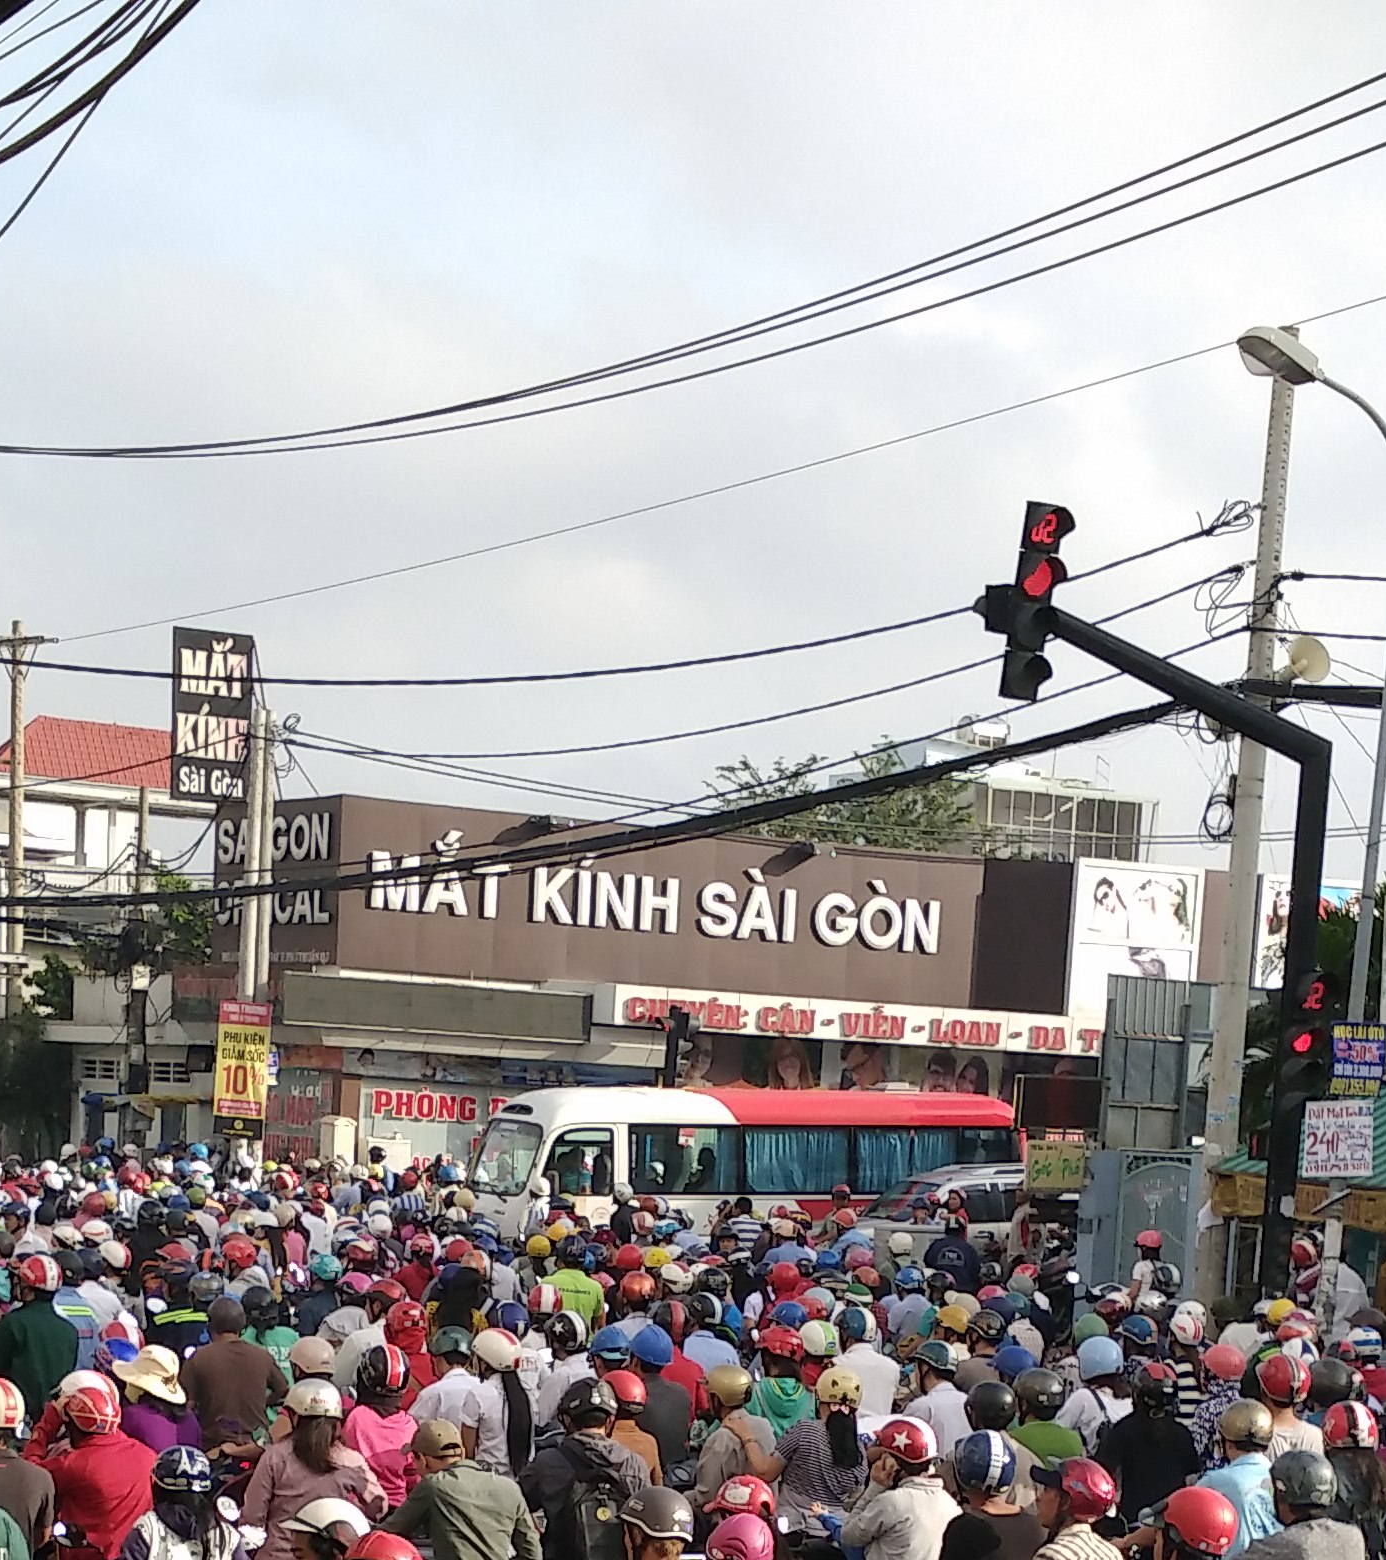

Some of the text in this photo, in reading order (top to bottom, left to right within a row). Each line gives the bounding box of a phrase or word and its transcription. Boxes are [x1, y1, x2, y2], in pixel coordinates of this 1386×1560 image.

[179, 637, 248, 699] MẮT
[176, 701, 250, 763] KÍNH
[178, 766, 245, 798] Sài Gòn
[218, 812, 330, 866] SAGON
[368, 829, 942, 955] MẮT KÍNH SÀI GÒN
[244, 1031, 265, 1047] KIỆN
[840, 1005, 907, 1041] VIỄN
[222, 1046, 245, 1061] GIẢM
[223, 1064, 265, 1096] 10%
[373, 1086, 478, 1123] PHÒNG
